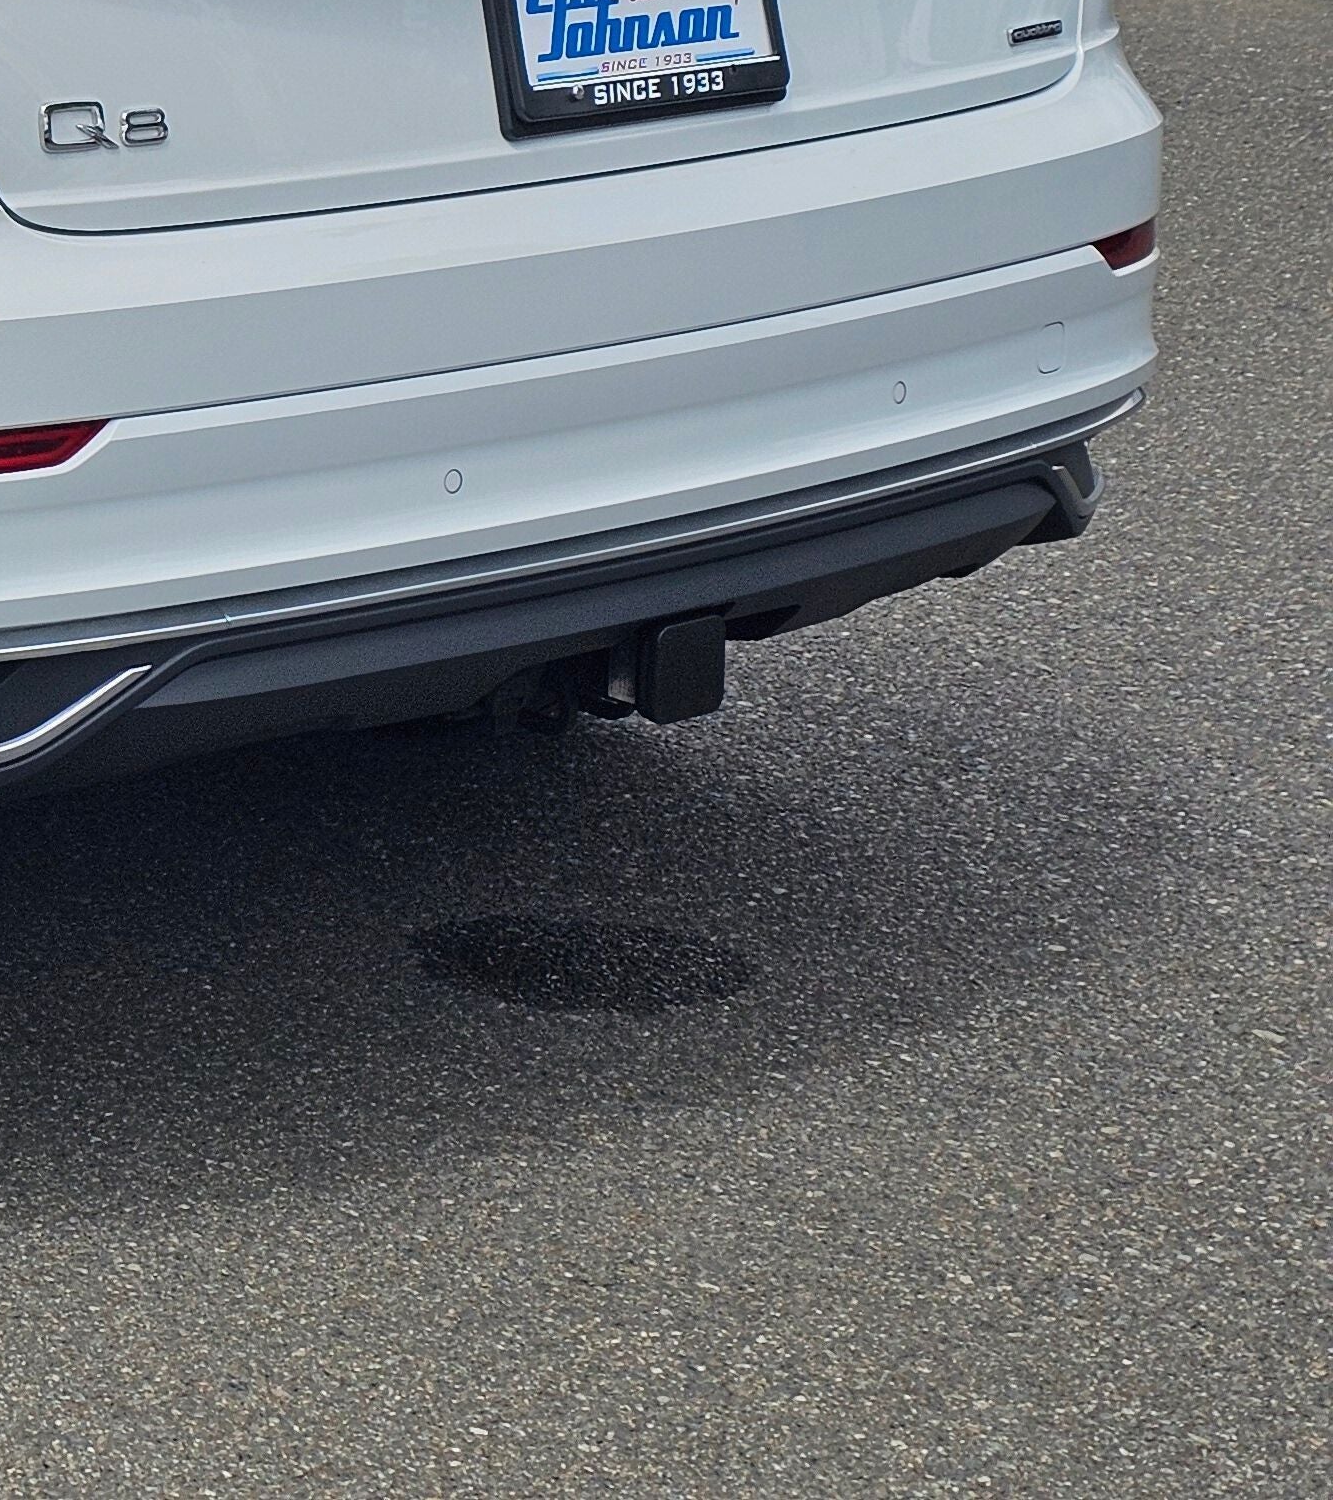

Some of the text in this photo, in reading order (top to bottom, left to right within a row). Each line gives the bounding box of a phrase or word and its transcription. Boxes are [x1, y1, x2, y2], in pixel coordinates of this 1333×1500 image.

[600, 52, 692, 73] SINCE 1933
[594, 70, 724, 105] SINCE 1933
[38, 100, 169, 154] Q8
